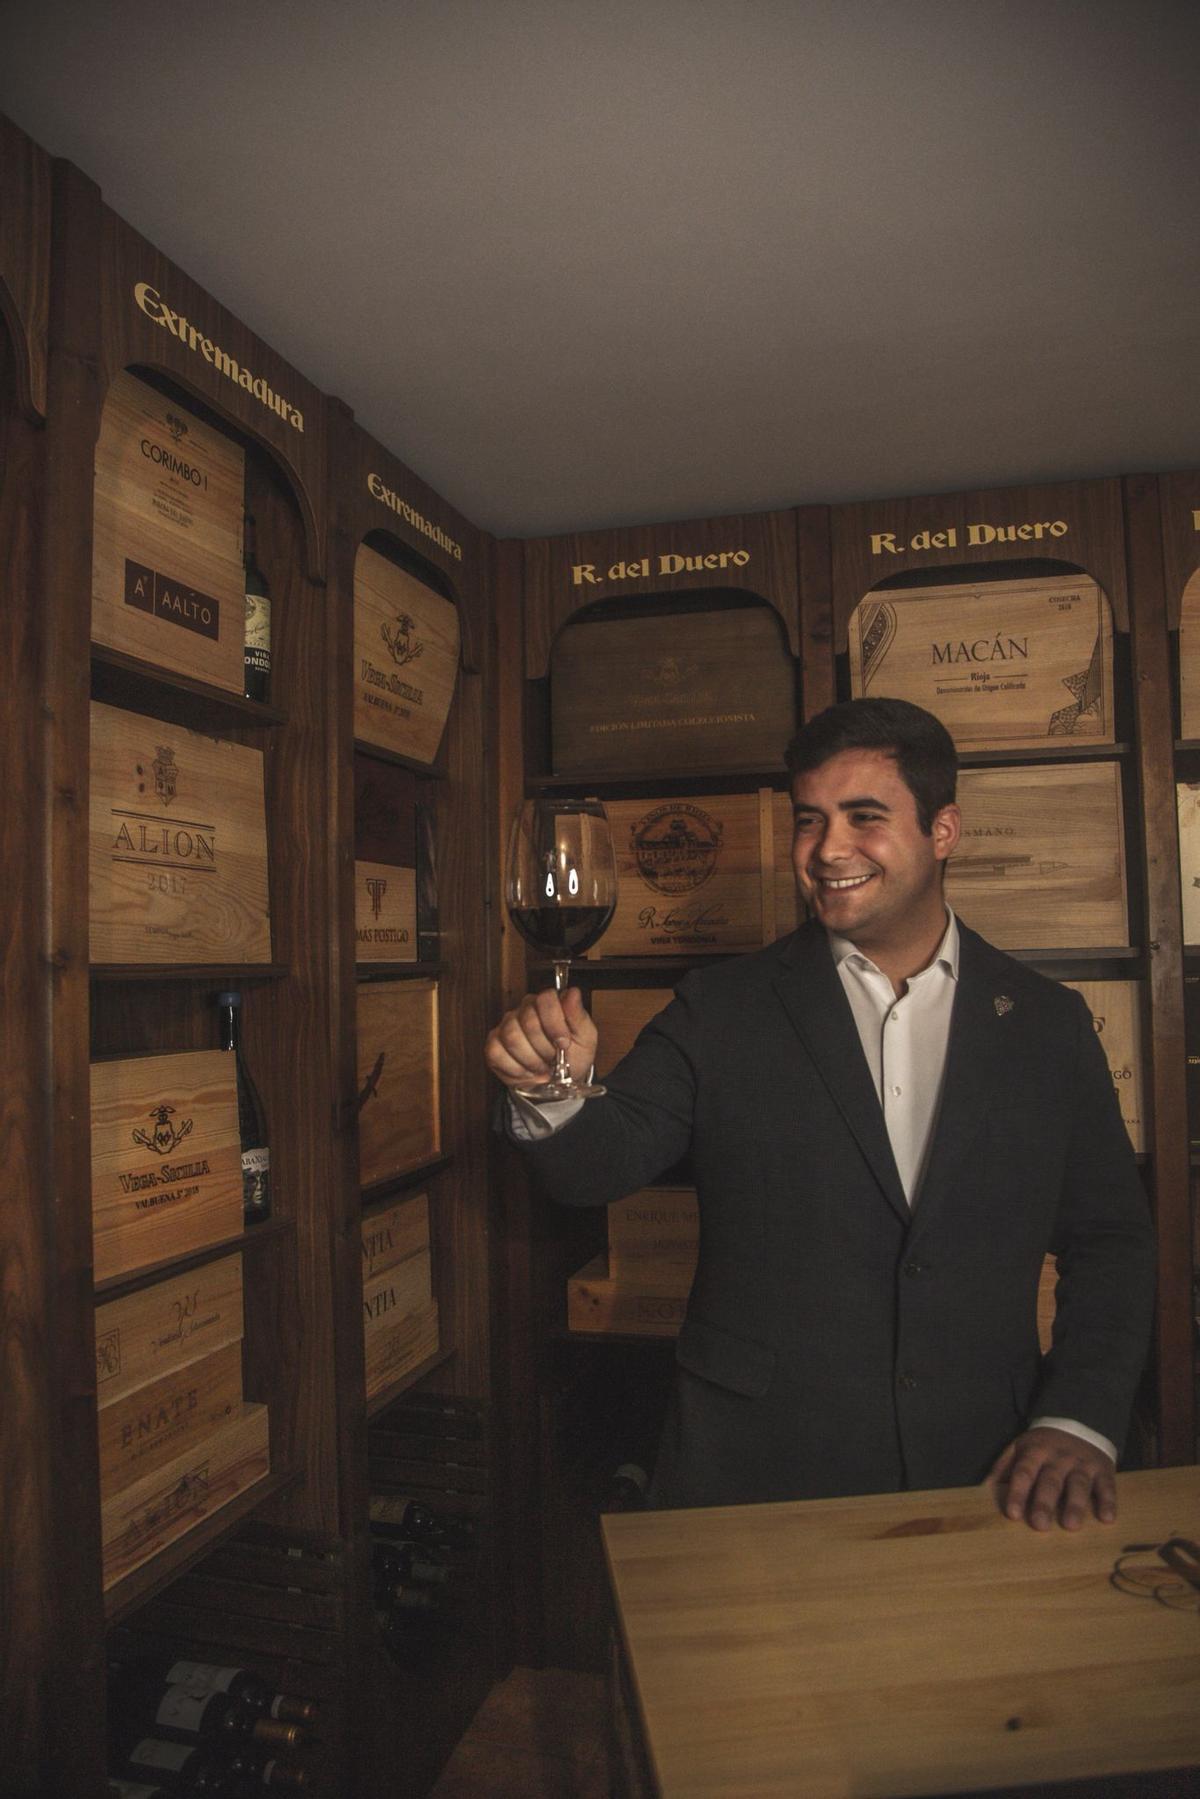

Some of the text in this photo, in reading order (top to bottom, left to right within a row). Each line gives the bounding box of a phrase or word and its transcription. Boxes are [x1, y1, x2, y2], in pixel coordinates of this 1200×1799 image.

[134, 282, 304, 433] Extremadura
[141, 440, 201, 486] CORIMBO
[367, 472, 462, 561] Extremadura
[870, 520, 1068, 555] R. del Duero
[571, 550, 751, 585] R. del Duero
[161, 591, 212, 625] AALTO
[932, 631, 1028, 665] MACÁN
[970, 672, 991, 683] Rioja
[374, 928, 409, 943] POSTIGO
